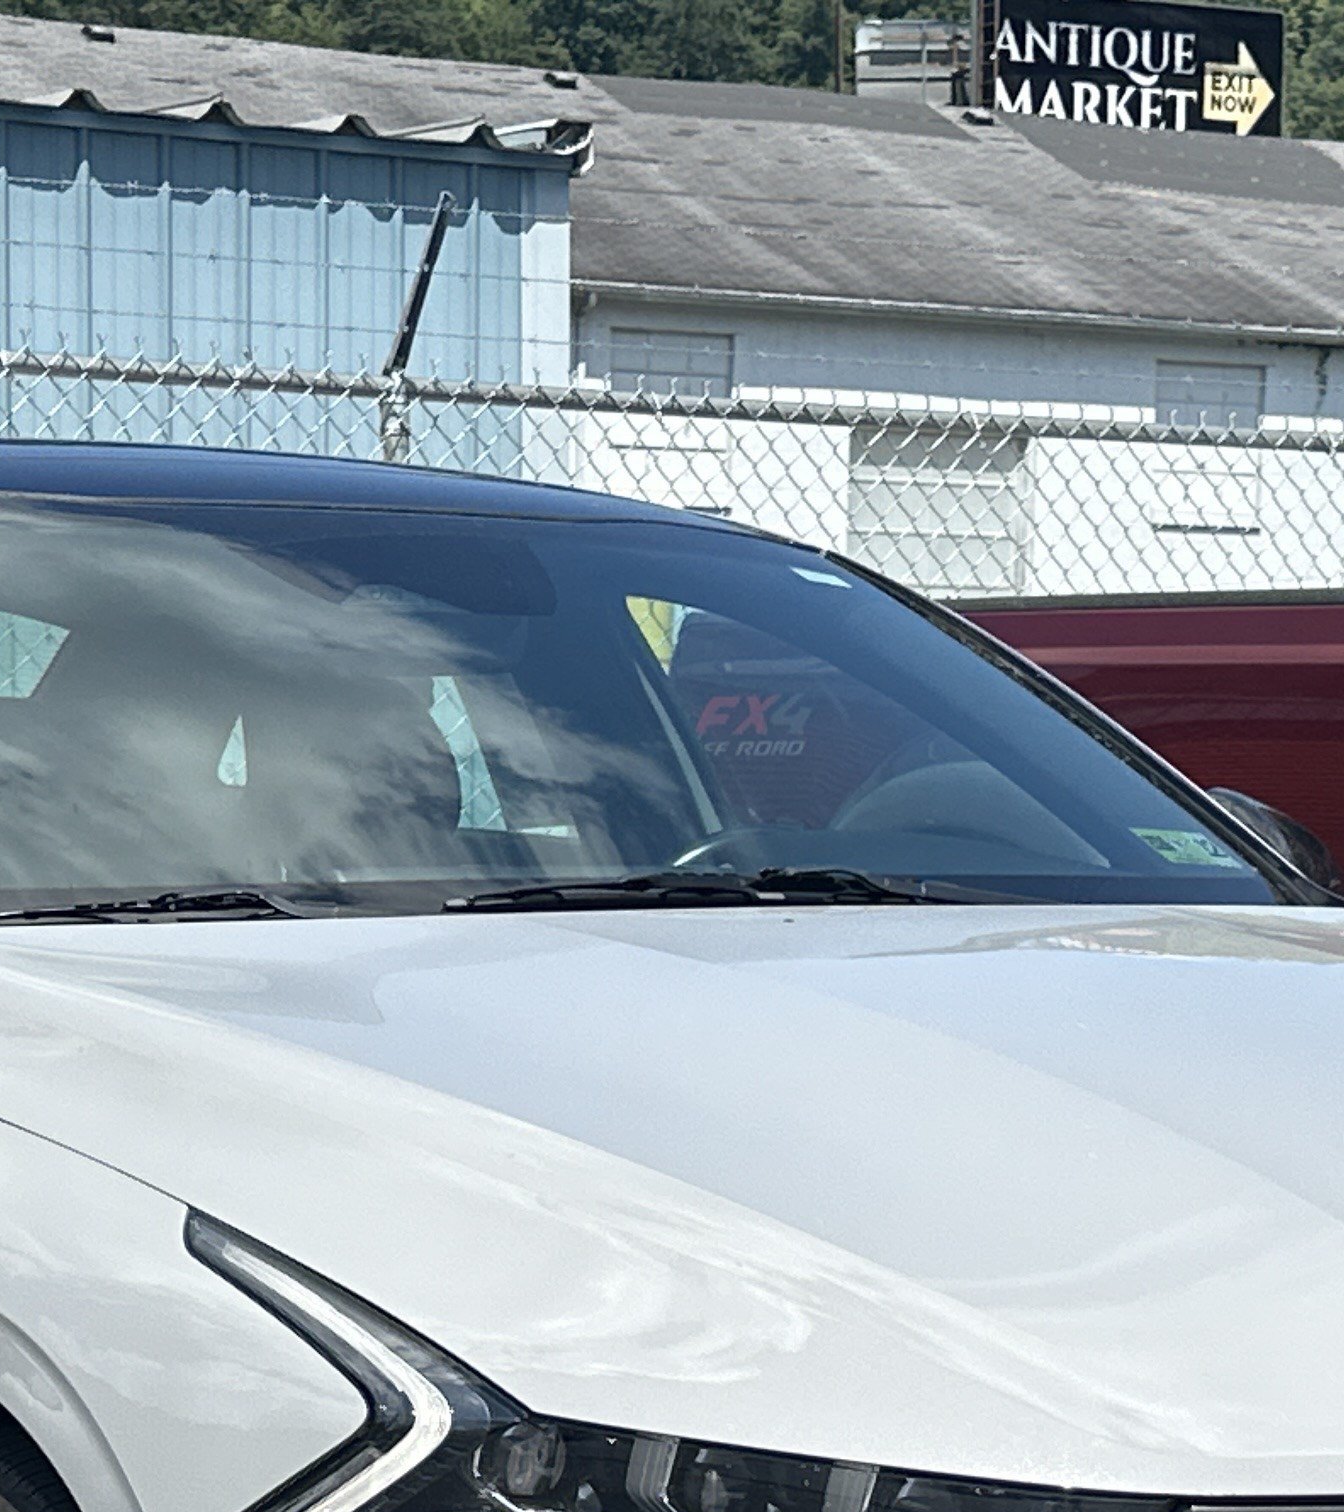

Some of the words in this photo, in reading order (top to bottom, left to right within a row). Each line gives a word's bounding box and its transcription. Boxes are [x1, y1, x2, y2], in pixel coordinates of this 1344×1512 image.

[990, 18, 1196, 86] ANTIQUE
[1210, 72, 1255, 92] EXIT
[995, 77, 1198, 133] MARKET
[1210, 94, 1256, 114] NOW
[696, 694, 812, 736] FX4
[735, 740, 806, 756] ROAD
